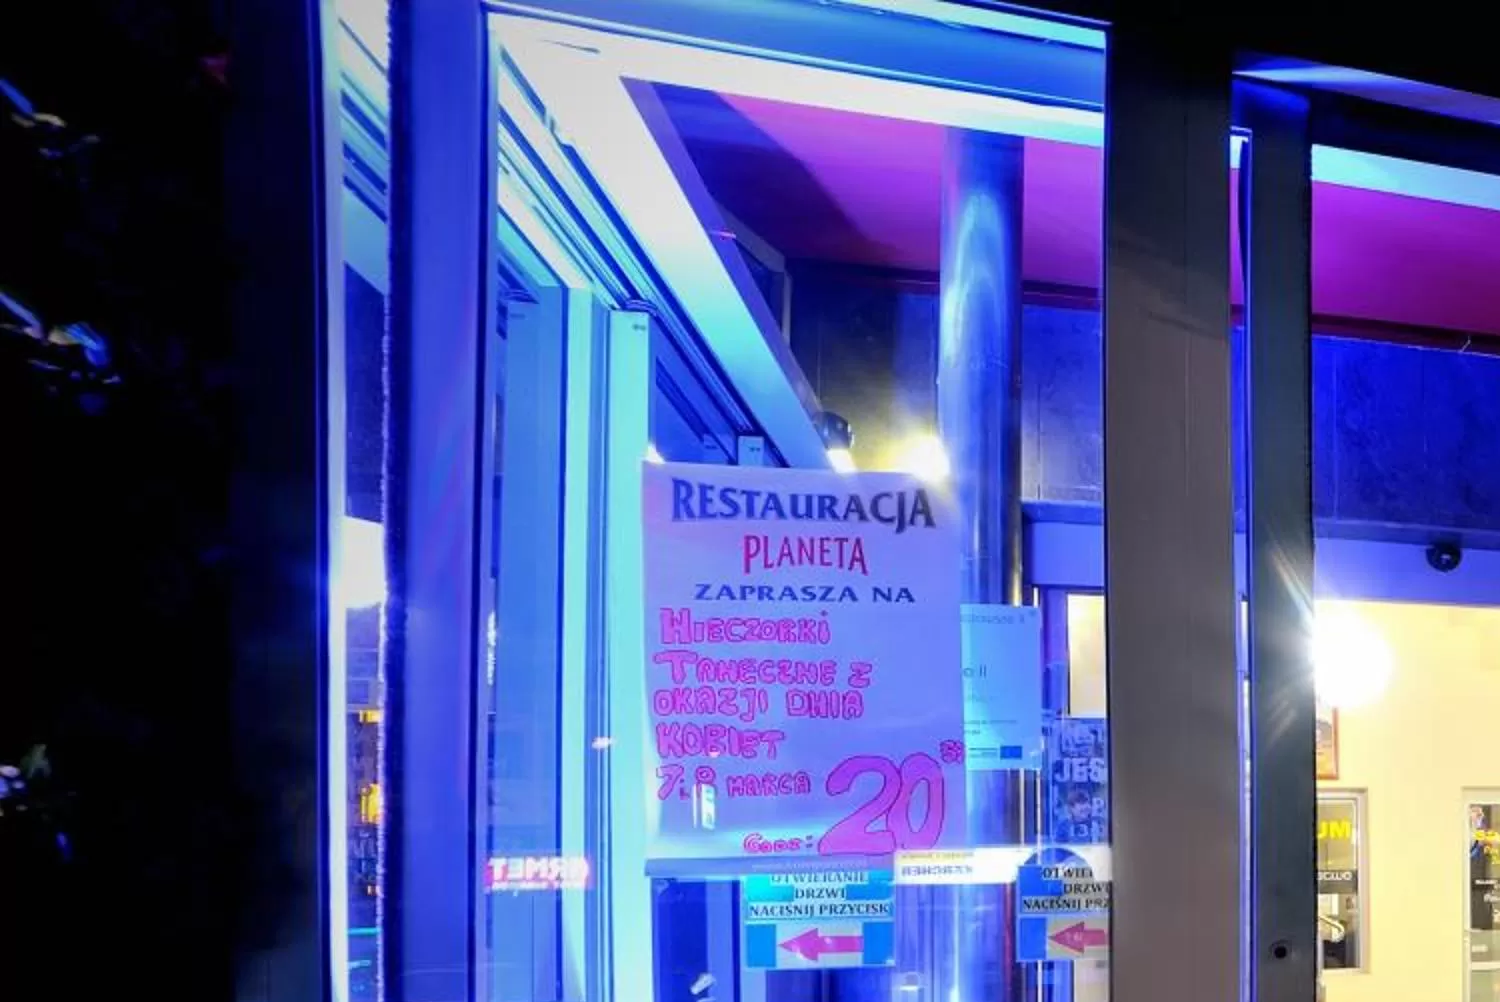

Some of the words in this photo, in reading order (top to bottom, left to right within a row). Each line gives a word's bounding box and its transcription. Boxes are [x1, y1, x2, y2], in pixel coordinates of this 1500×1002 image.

[672, 478, 936, 533] RESTAURACJA
[743, 535, 868, 575] PLANETA
[694, 584, 857, 602] ZAPRASZA
[873, 587, 915, 603] NA
[656, 722, 786, 760] KOBIET
[818, 753, 945, 856] 20
[794, 886, 846, 899] DRZWI
[819, 903, 889, 915] PRZYCISK
